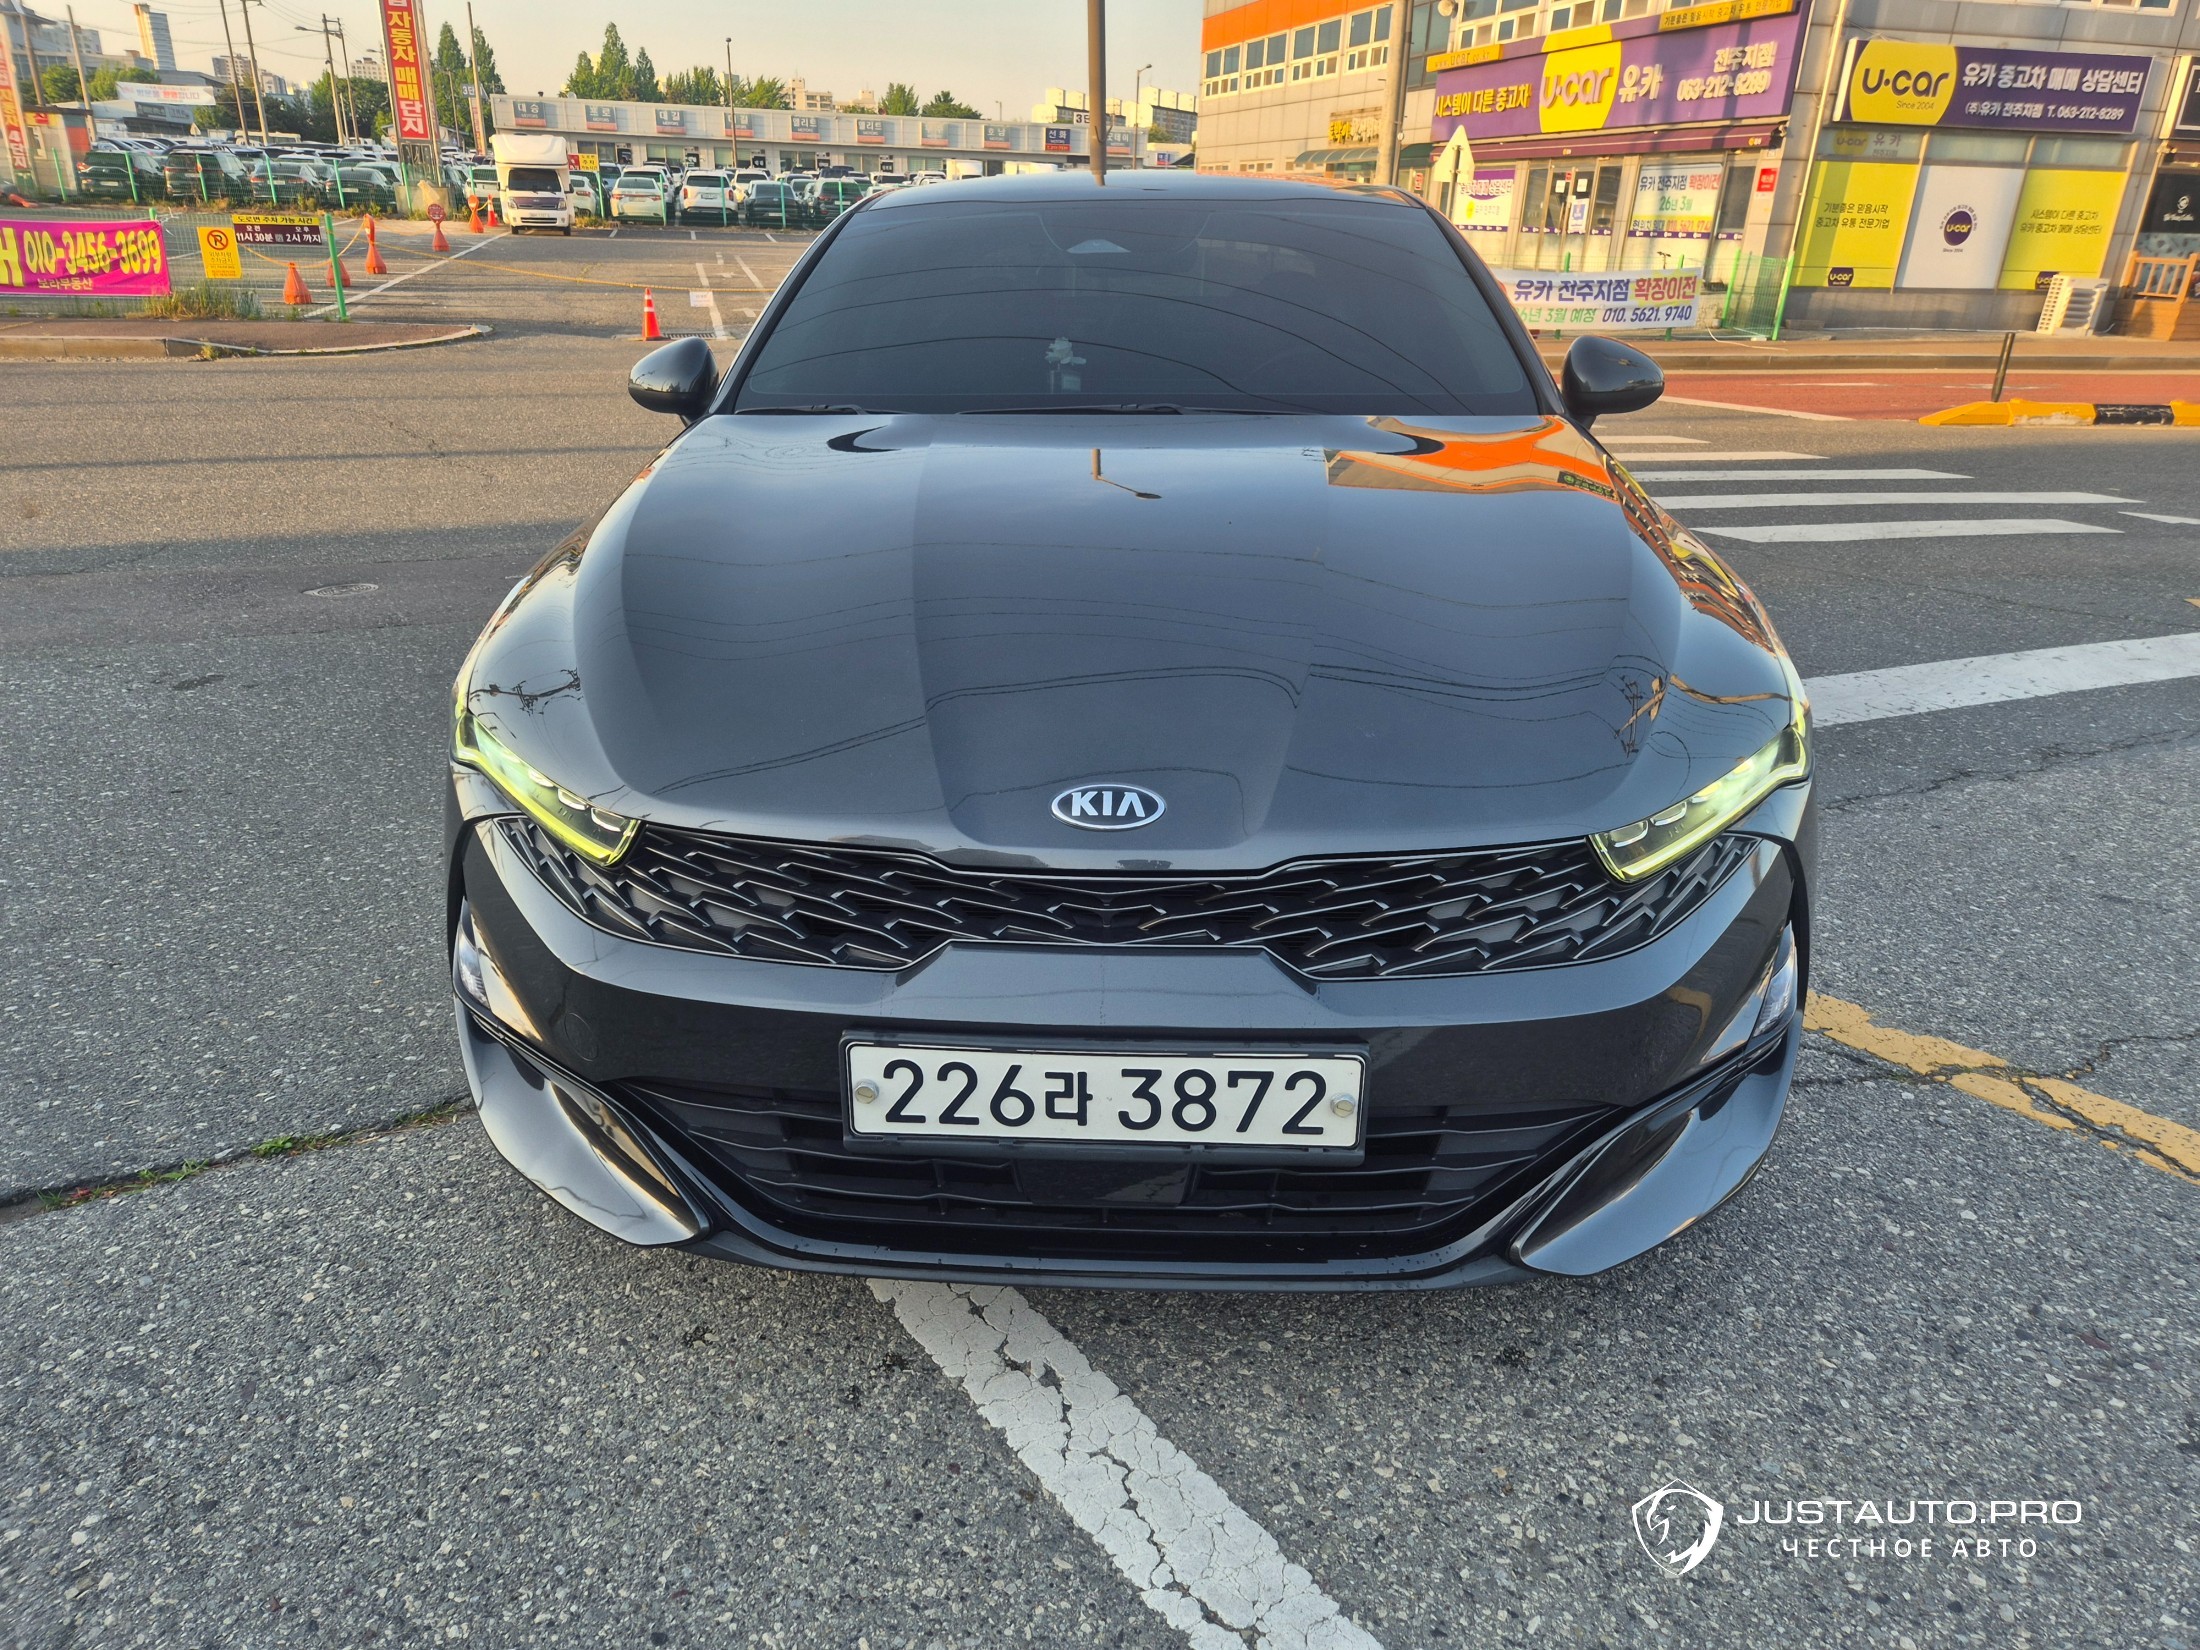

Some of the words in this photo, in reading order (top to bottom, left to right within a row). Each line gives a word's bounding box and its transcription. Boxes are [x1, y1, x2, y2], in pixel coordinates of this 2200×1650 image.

[1713, 41, 1777, 73] 전주지점
[1676, 70, 1771, 101] 063-212-8289
[1962, 62, 1997, 87] 유카
[1998, 65, 2047, 90] 중고차
[2048, 67, 2082, 92] 매매
[2082, 69, 2144, 95] 상담센터
[1434, 92, 1472, 117] 시스템이
[1472, 88, 1495, 112] 다른
[1496, 83, 1533, 113] 중고차
[1618, 64, 1664, 103] 유카
[1896, 100, 1915, 110] Since
[1916, 102, 1935, 111] 2004
[2002, 102, 2042, 119] 전주지점
[1639, 176, 1656, 191] 유카
[1657, 174, 1688, 191] 전주지점
[1689, 173, 1722, 191] 확장이전
[1658, 196, 1678, 211] 26년
[1823, 202, 1856, 214] 기분좋은
[1857, 203, 1889, 215] 믿음시작
[1815, 216, 1840, 228] 중고차
[1840, 217, 1857, 229] 유통
[1858, 218, 1890, 230] 전문기업
[2060, 209, 2076, 221] 다른
[285, 233, 301, 243] 2시
[303, 233, 321, 243] 까지
[23, 230, 162, 275] 010-3456-3699
[38, 277, 94, 291] 보라부동산
[1514, 279, 1552, 302] 유카
[1557, 278, 1630, 302] 전주지점
[1633, 275, 1698, 302] 확장이전
[1516, 307, 1542, 323] 6년
[1544, 307, 1567, 323] 3월
[1570, 307, 1598, 323] 예정
[1602, 307, 1627, 323] 010.
[1630, 306, 1661, 323] 5621.
[1664, 305, 1692, 322] 9740
[1071, 790, 1146, 818] KIA
[883, 1059, 1093, 1127] 226라
[1117, 1068, 1328, 1135] 3872
